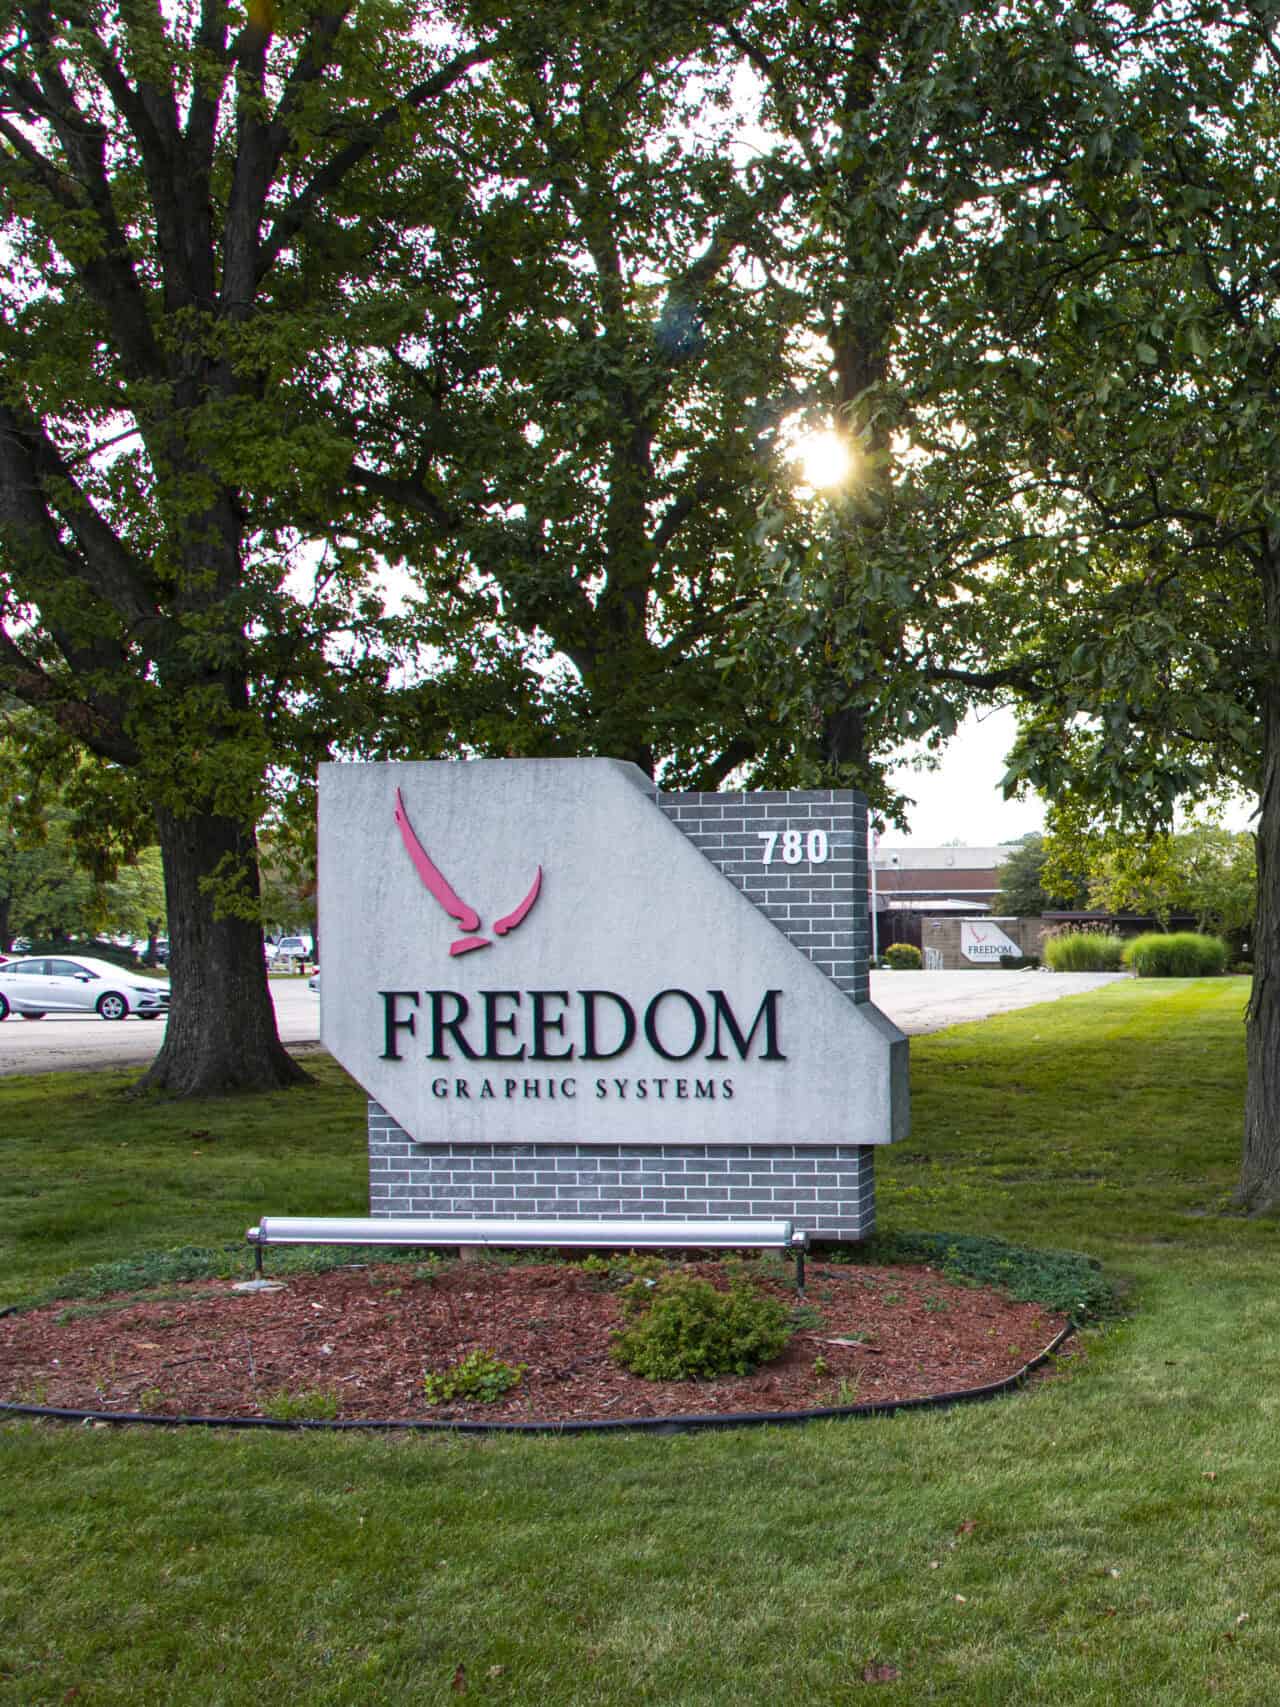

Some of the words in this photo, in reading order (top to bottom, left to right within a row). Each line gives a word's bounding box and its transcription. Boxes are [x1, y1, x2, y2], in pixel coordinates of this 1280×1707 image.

[758, 829, 828, 865] 780
[967, 944, 1013, 954] FREEDOM
[378, 989, 787, 1062] FREEDOM
[431, 1078, 577, 1099] GRAPHIC
[596, 1078, 735, 1099] SYSTEMS
